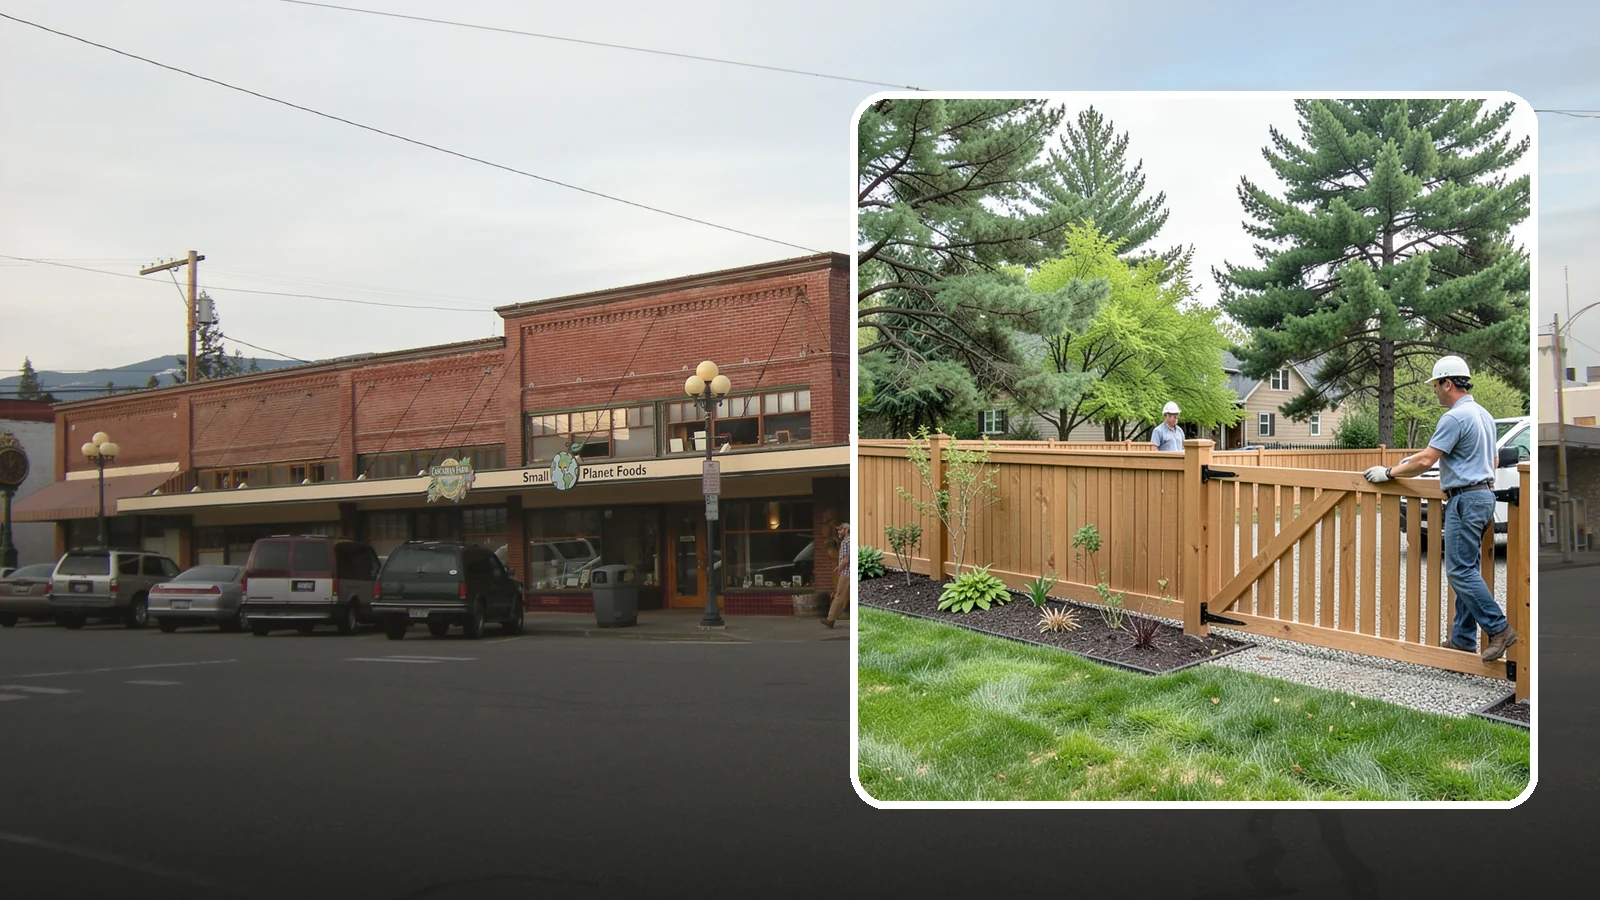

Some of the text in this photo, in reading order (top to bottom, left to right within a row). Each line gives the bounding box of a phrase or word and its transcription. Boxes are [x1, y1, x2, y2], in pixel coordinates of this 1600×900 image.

[431, 466, 469, 476] CASCADIAN FARM
[523, 464, 647, 483] Small Planet Foods
